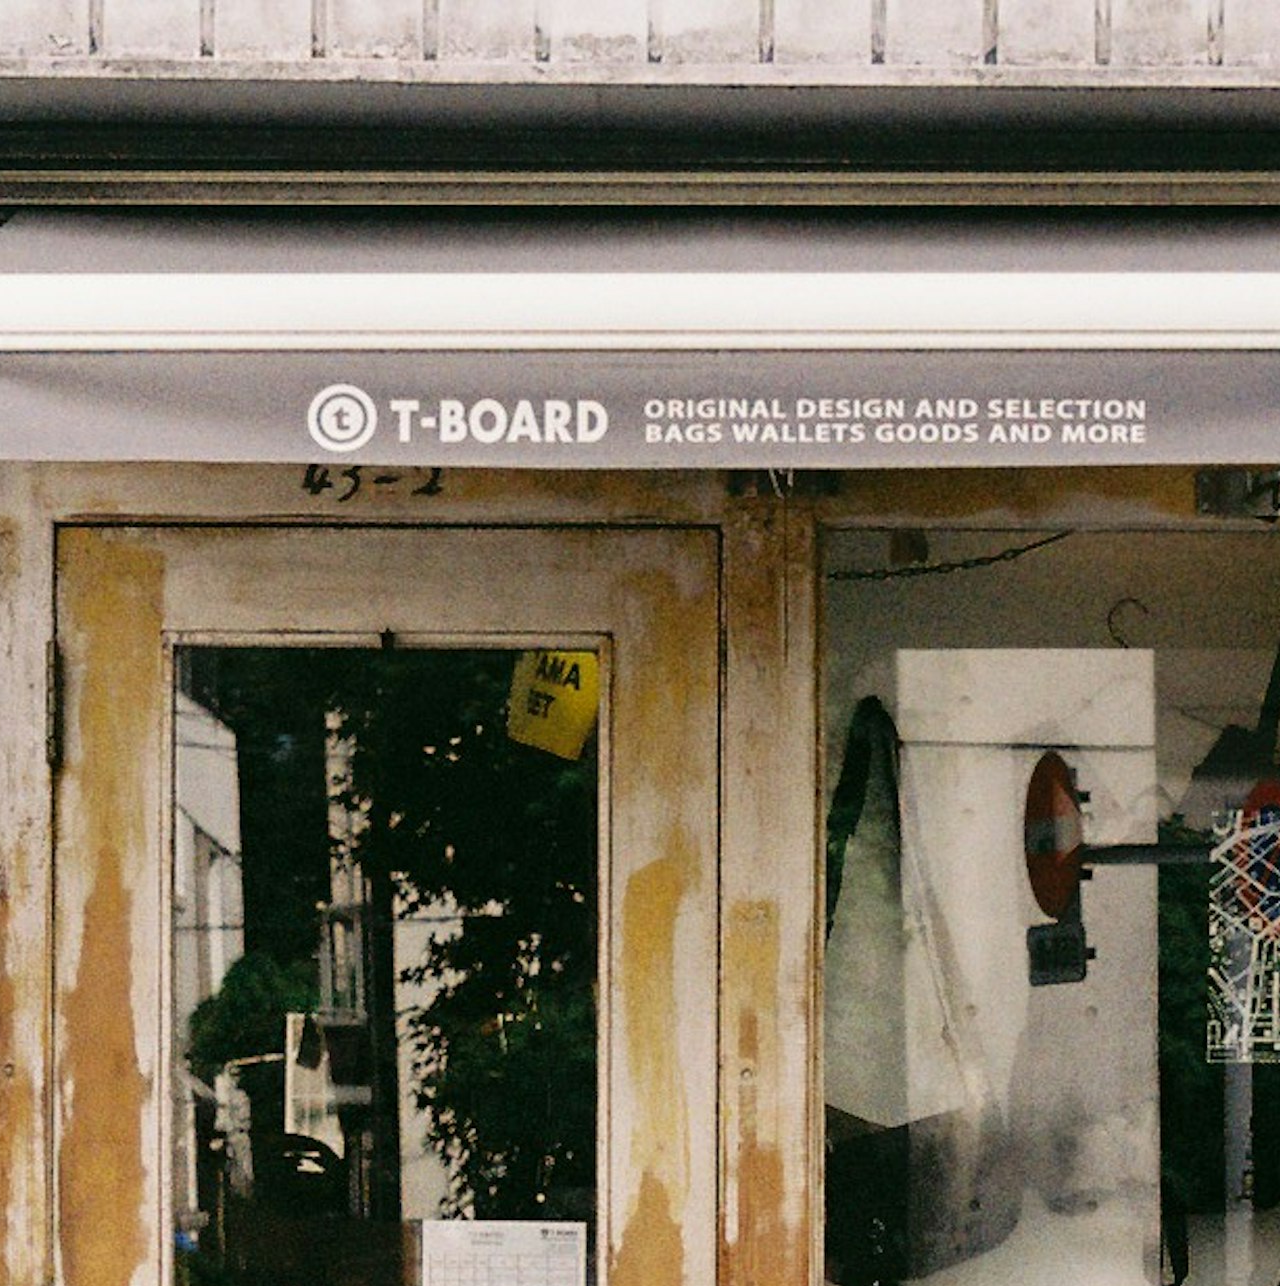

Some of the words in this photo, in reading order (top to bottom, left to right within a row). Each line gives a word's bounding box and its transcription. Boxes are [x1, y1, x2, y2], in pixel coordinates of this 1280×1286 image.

[644, 399, 787, 419] ORIGINAL
[796, 399, 905, 419] DESIGN
[914, 399, 979, 419] AND
[987, 399, 1146, 420] SELECTION
[389, 398, 609, 444] T-BOARD
[645, 423, 723, 444] BAGS
[732, 423, 866, 443] WALLETS
[874, 423, 980, 444] GOODS
[988, 424, 1052, 444] AND
[1061, 424, 1146, 444] MORE
